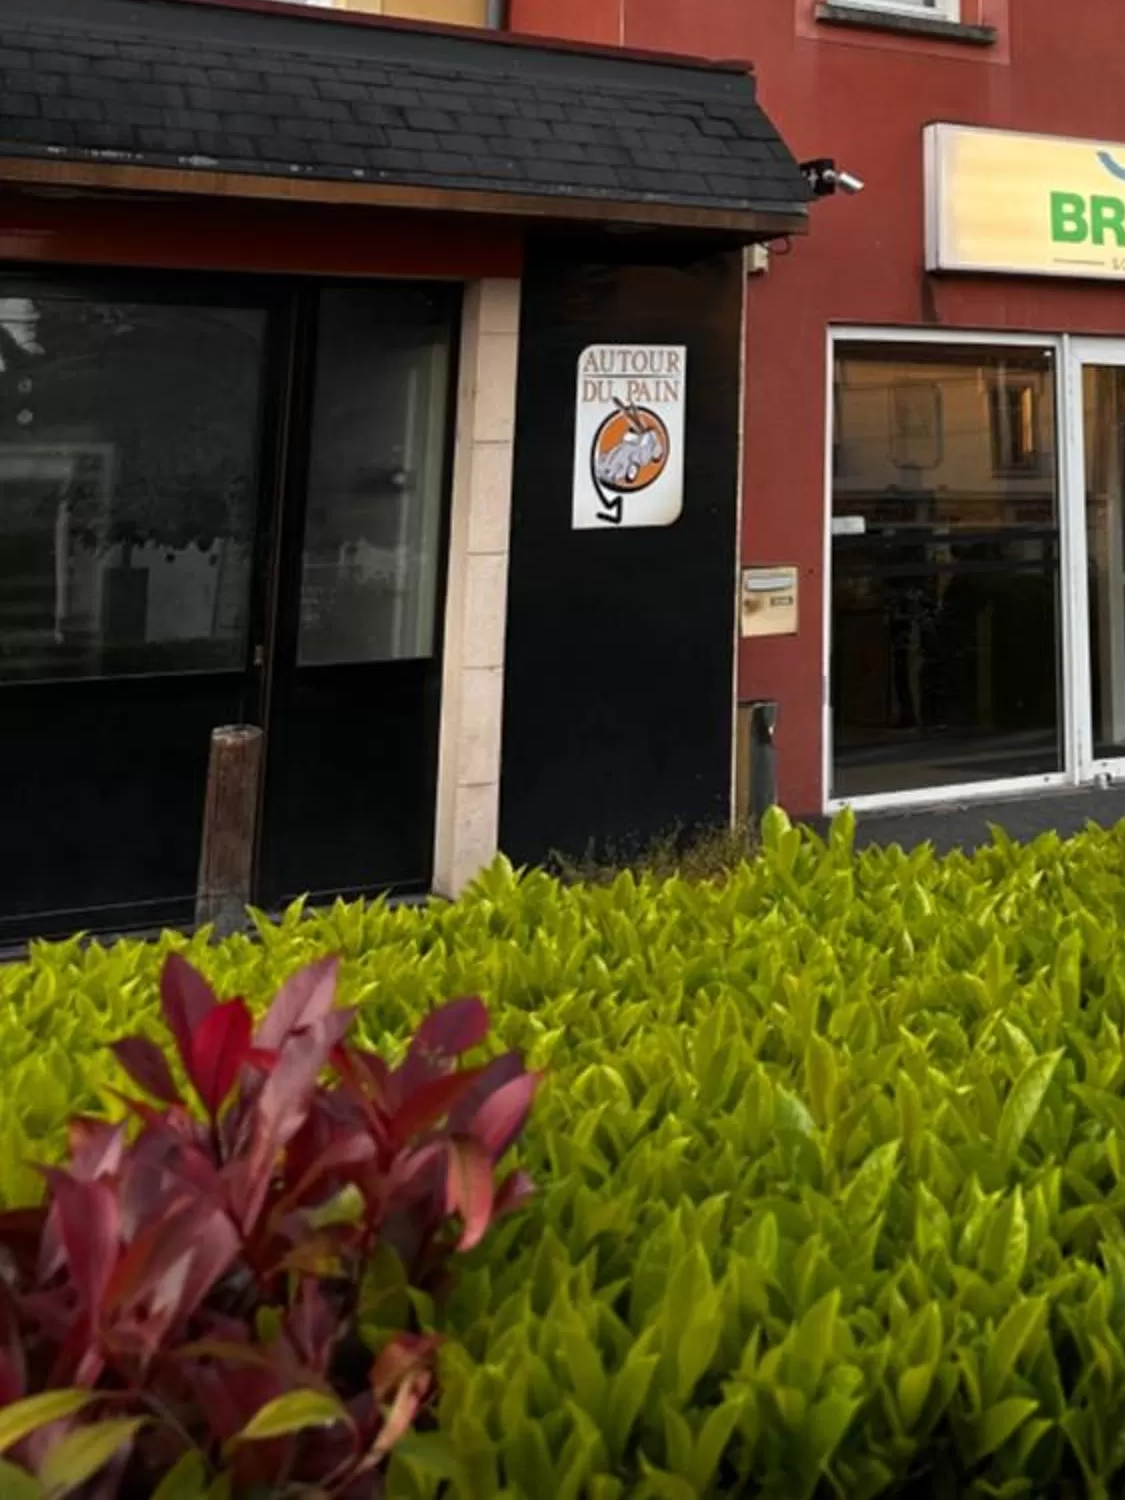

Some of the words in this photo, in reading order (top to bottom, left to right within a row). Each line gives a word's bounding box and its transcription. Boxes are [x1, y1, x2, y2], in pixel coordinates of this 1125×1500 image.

[584, 350, 681, 373] AUTOUR
[583, 379, 613, 401] DU
[627, 379, 680, 403] PAIN
